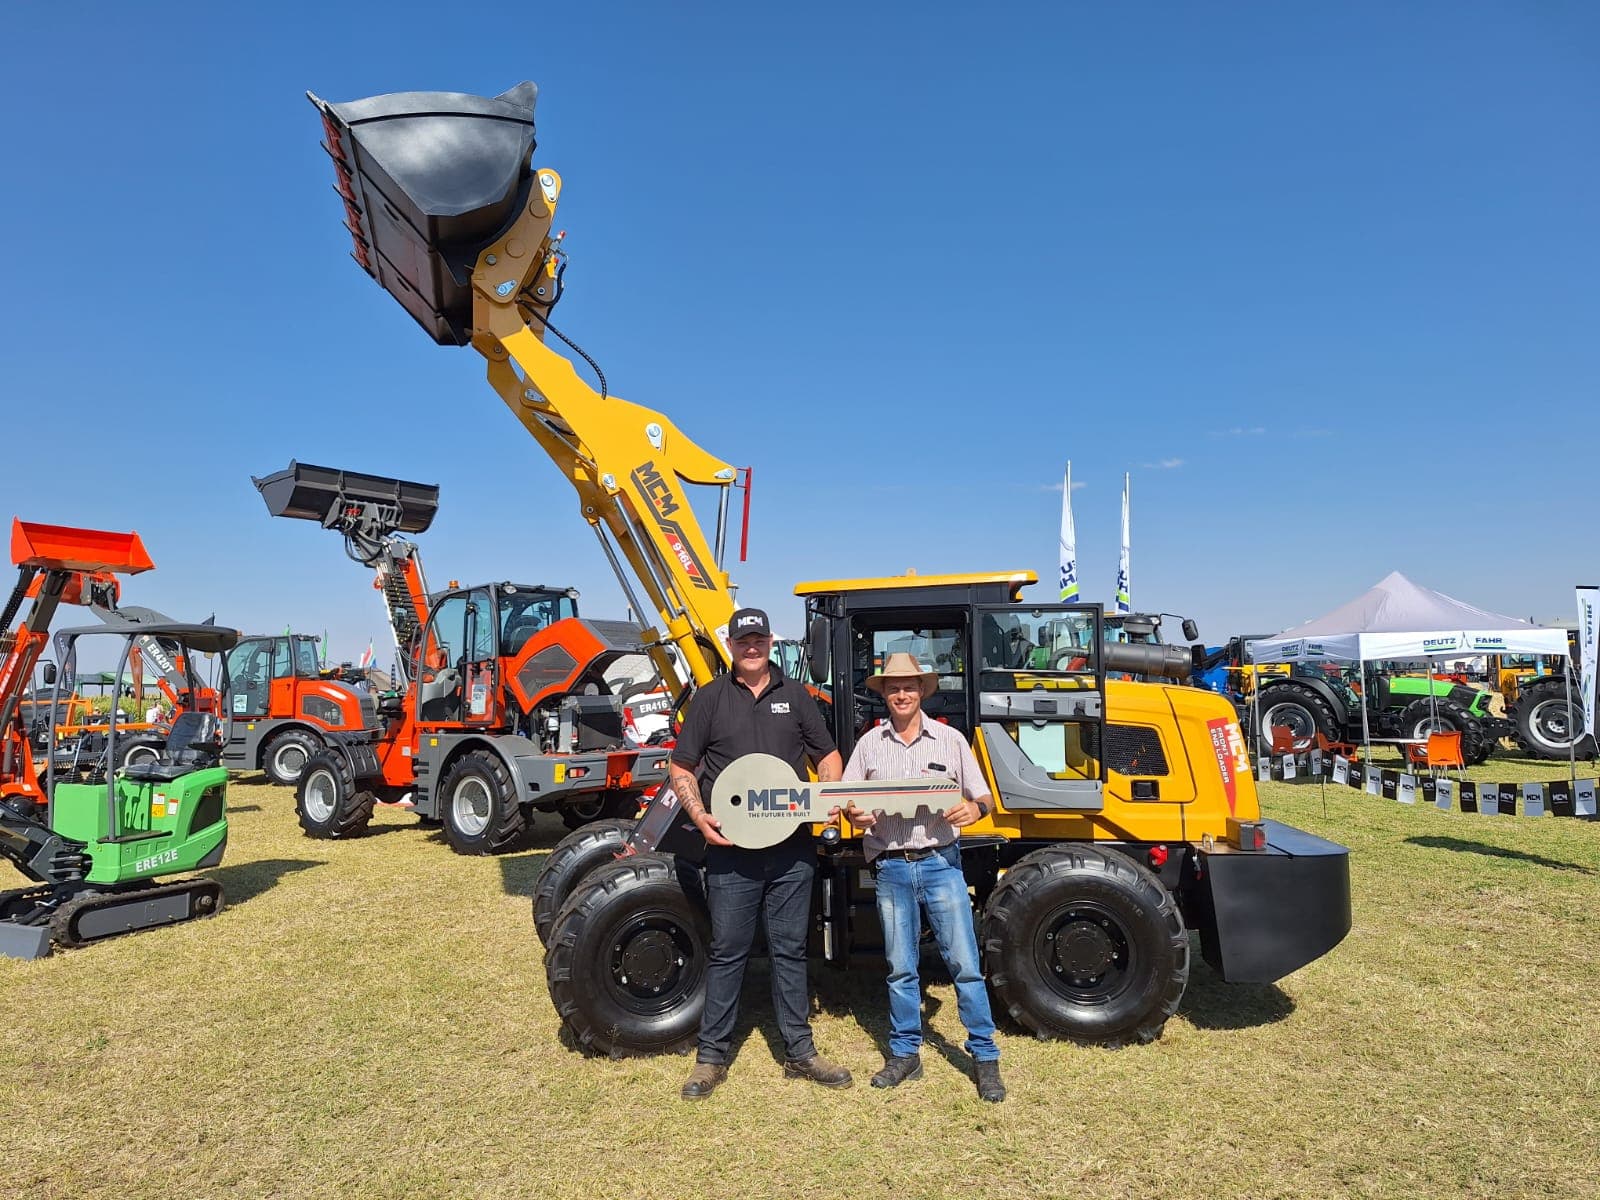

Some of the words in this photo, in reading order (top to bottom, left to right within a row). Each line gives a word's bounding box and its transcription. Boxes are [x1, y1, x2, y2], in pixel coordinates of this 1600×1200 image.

[635, 460, 680, 517] MCM
[672, 542, 692, 570] 916L
[737, 616, 763, 628] MCM
[1423, 638, 1457, 646] DEUTZ
[147, 643, 174, 672] ER420T
[640, 701, 668, 713] ER416
[1216, 727, 1229, 756] FRONT
[1224, 723, 1249, 773] MCM
[1210, 728, 1220, 747] END
[1216, 748, 1231, 784] LOADER
[747, 788, 811, 811] MCM
[136, 849, 178, 873] ERE12E
